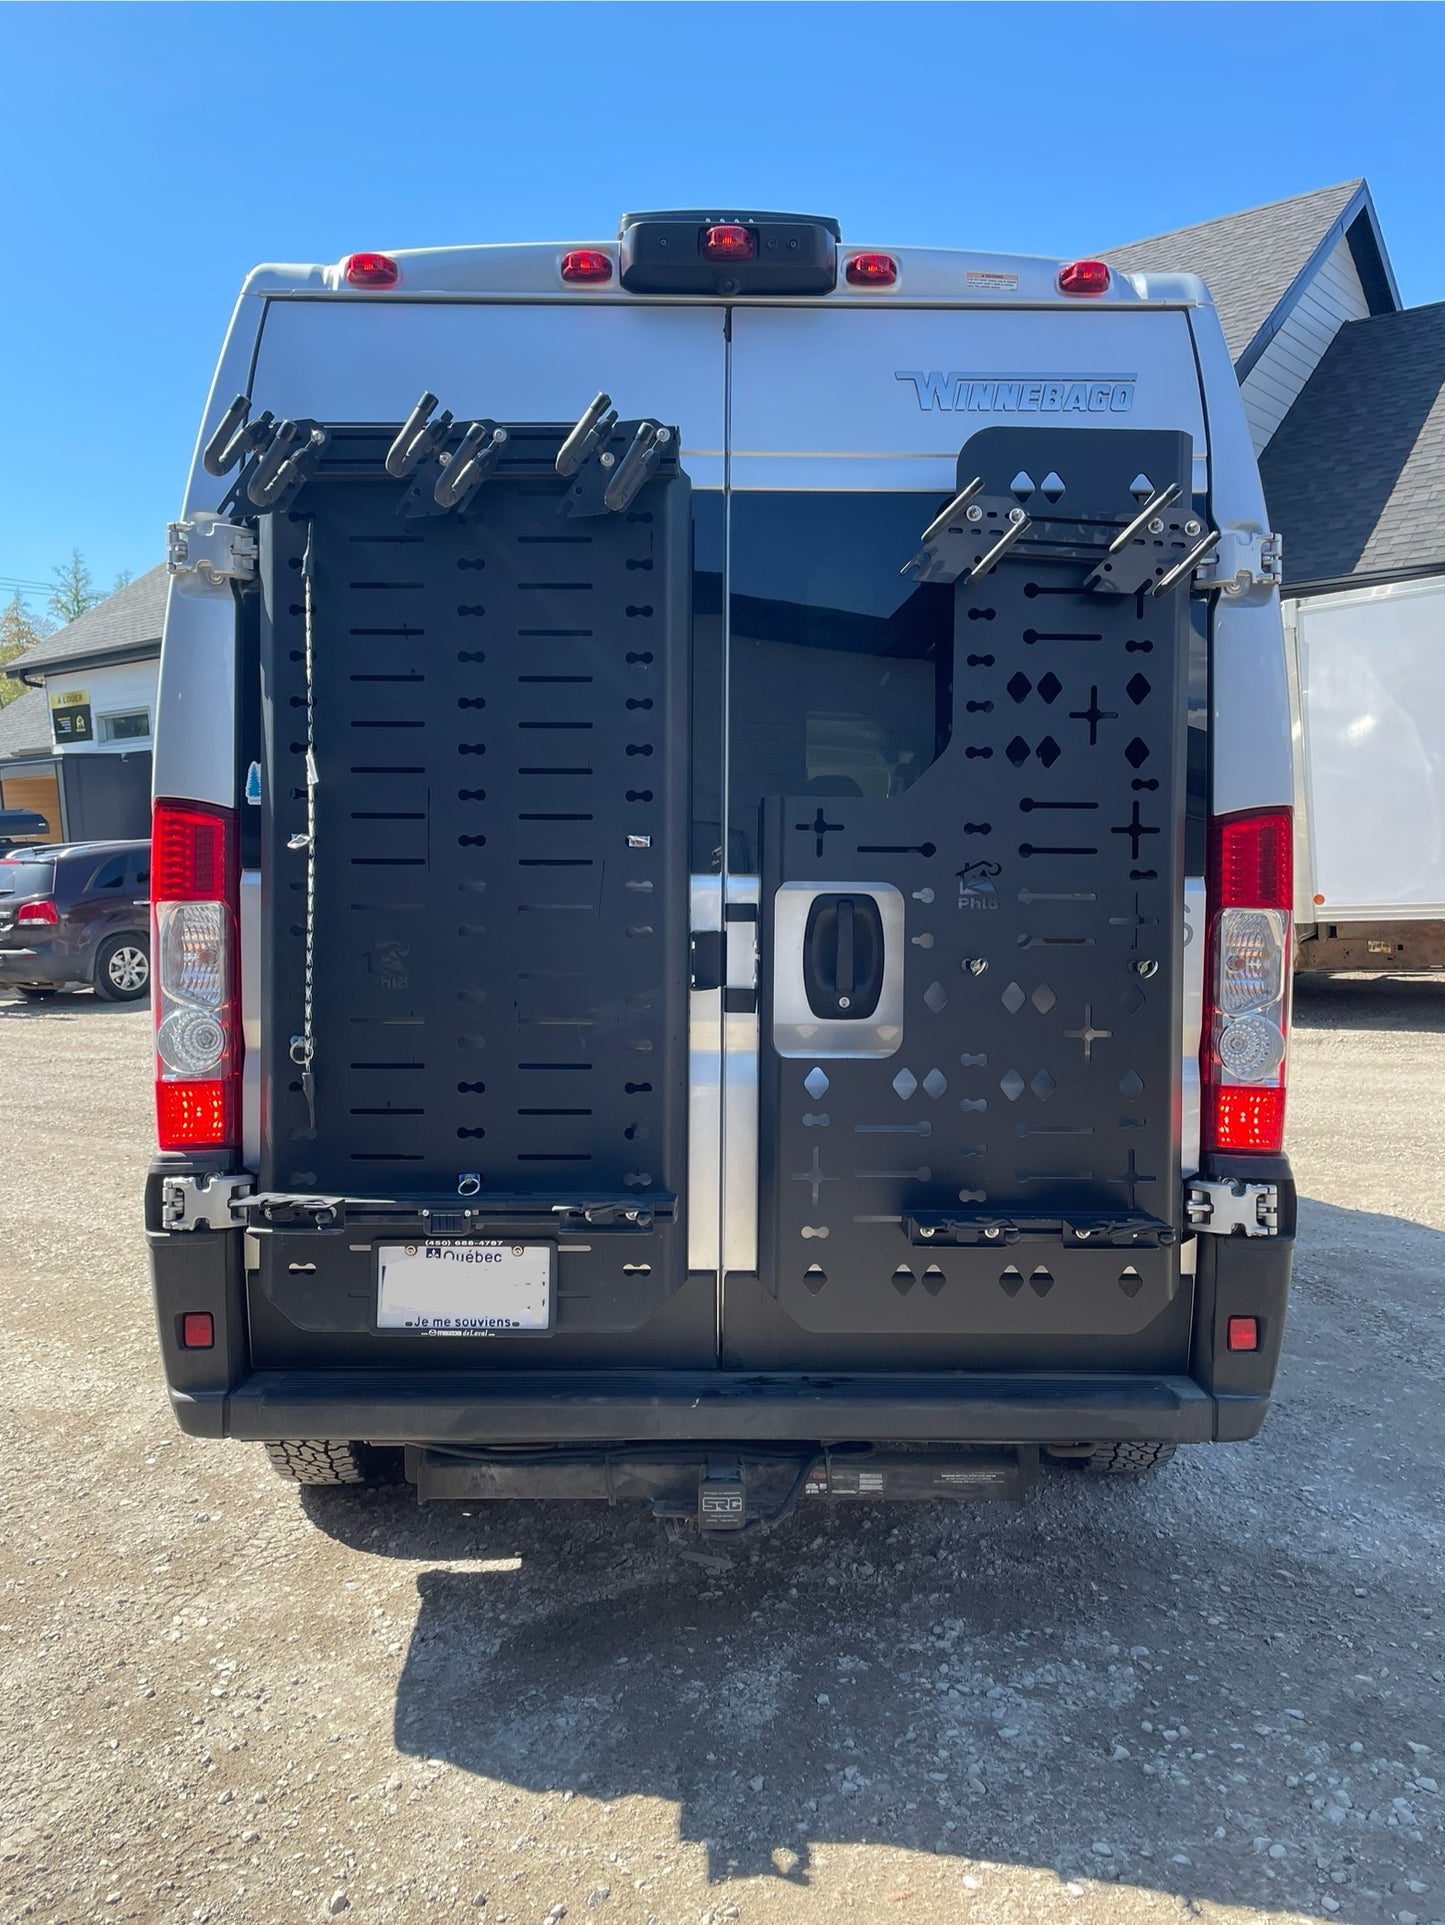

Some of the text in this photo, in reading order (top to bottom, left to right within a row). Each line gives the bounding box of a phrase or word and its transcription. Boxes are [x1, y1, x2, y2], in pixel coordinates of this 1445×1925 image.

[894, 371, 1138, 412] WINNEBAGO
[414, 1316, 511, 1327] Je me souviens
[702, 1496, 743, 1512] SRG
